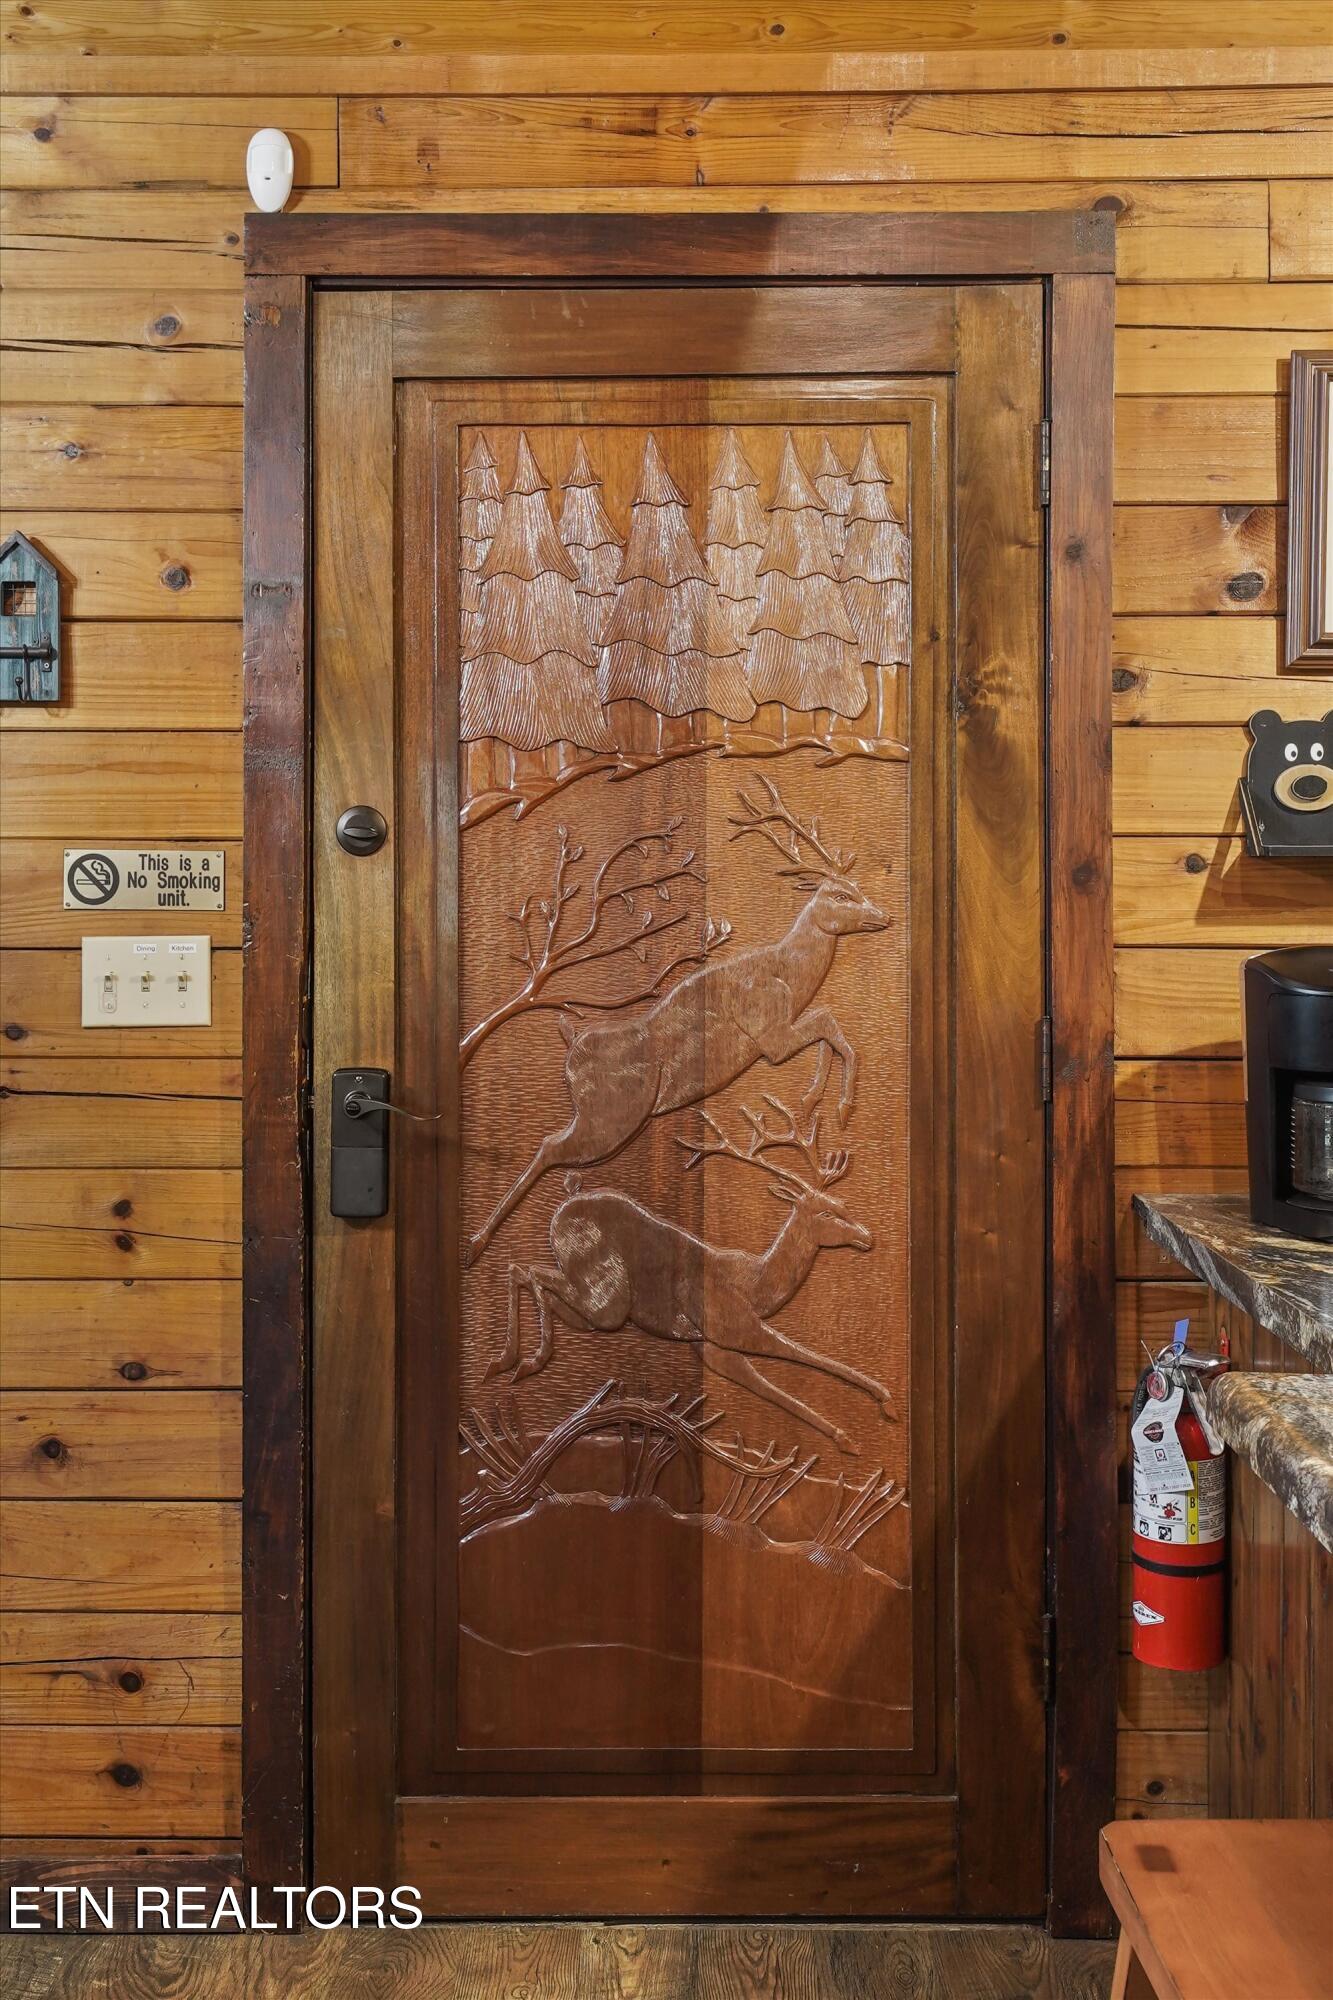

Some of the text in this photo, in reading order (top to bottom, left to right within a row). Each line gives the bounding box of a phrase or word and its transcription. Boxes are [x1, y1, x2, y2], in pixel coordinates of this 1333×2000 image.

[138, 853, 210, 871] This is a
[127, 871, 221, 893] No Smoking
[157, 889, 190, 907] unit.
[1190, 1496, 1196, 1509] B
[1190, 1523, 1196, 1536] C
